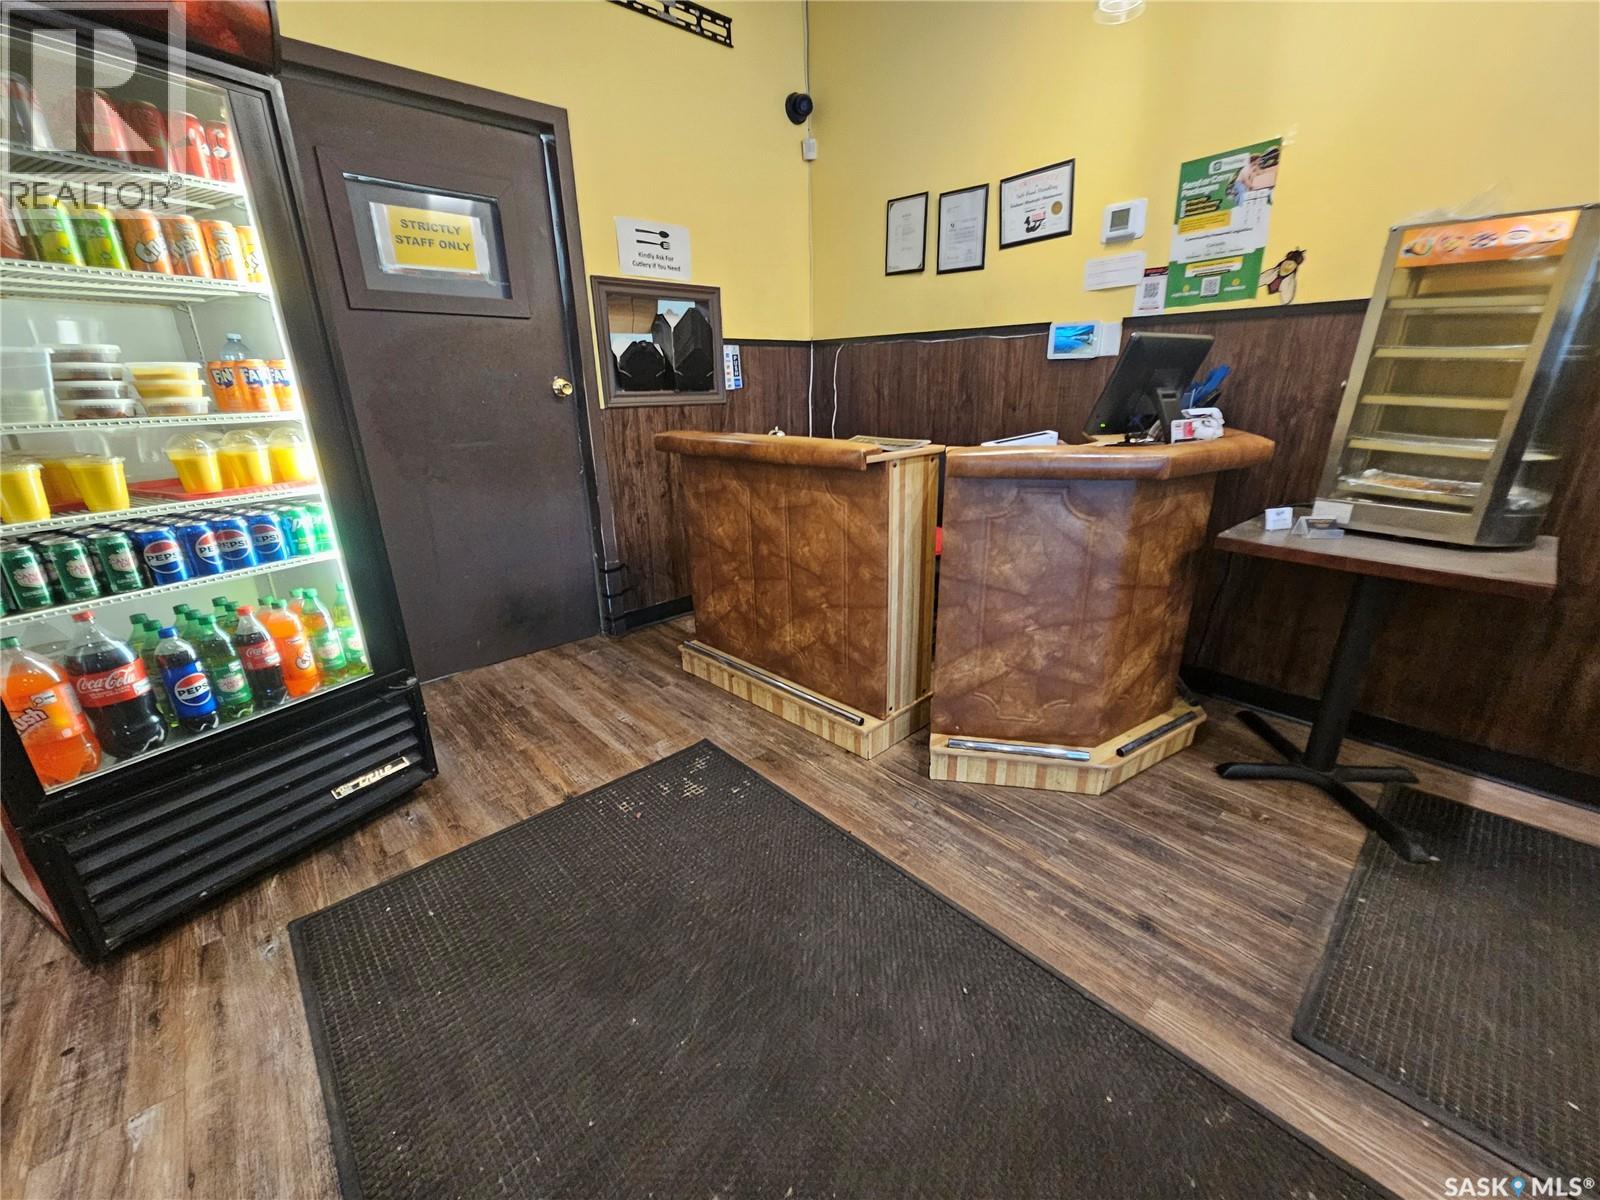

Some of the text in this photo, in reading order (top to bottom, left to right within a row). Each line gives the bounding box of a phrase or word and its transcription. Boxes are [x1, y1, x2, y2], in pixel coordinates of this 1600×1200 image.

[400, 218, 461, 236] STRICTLY
[395, 234, 470, 252] STAFF ONLY
